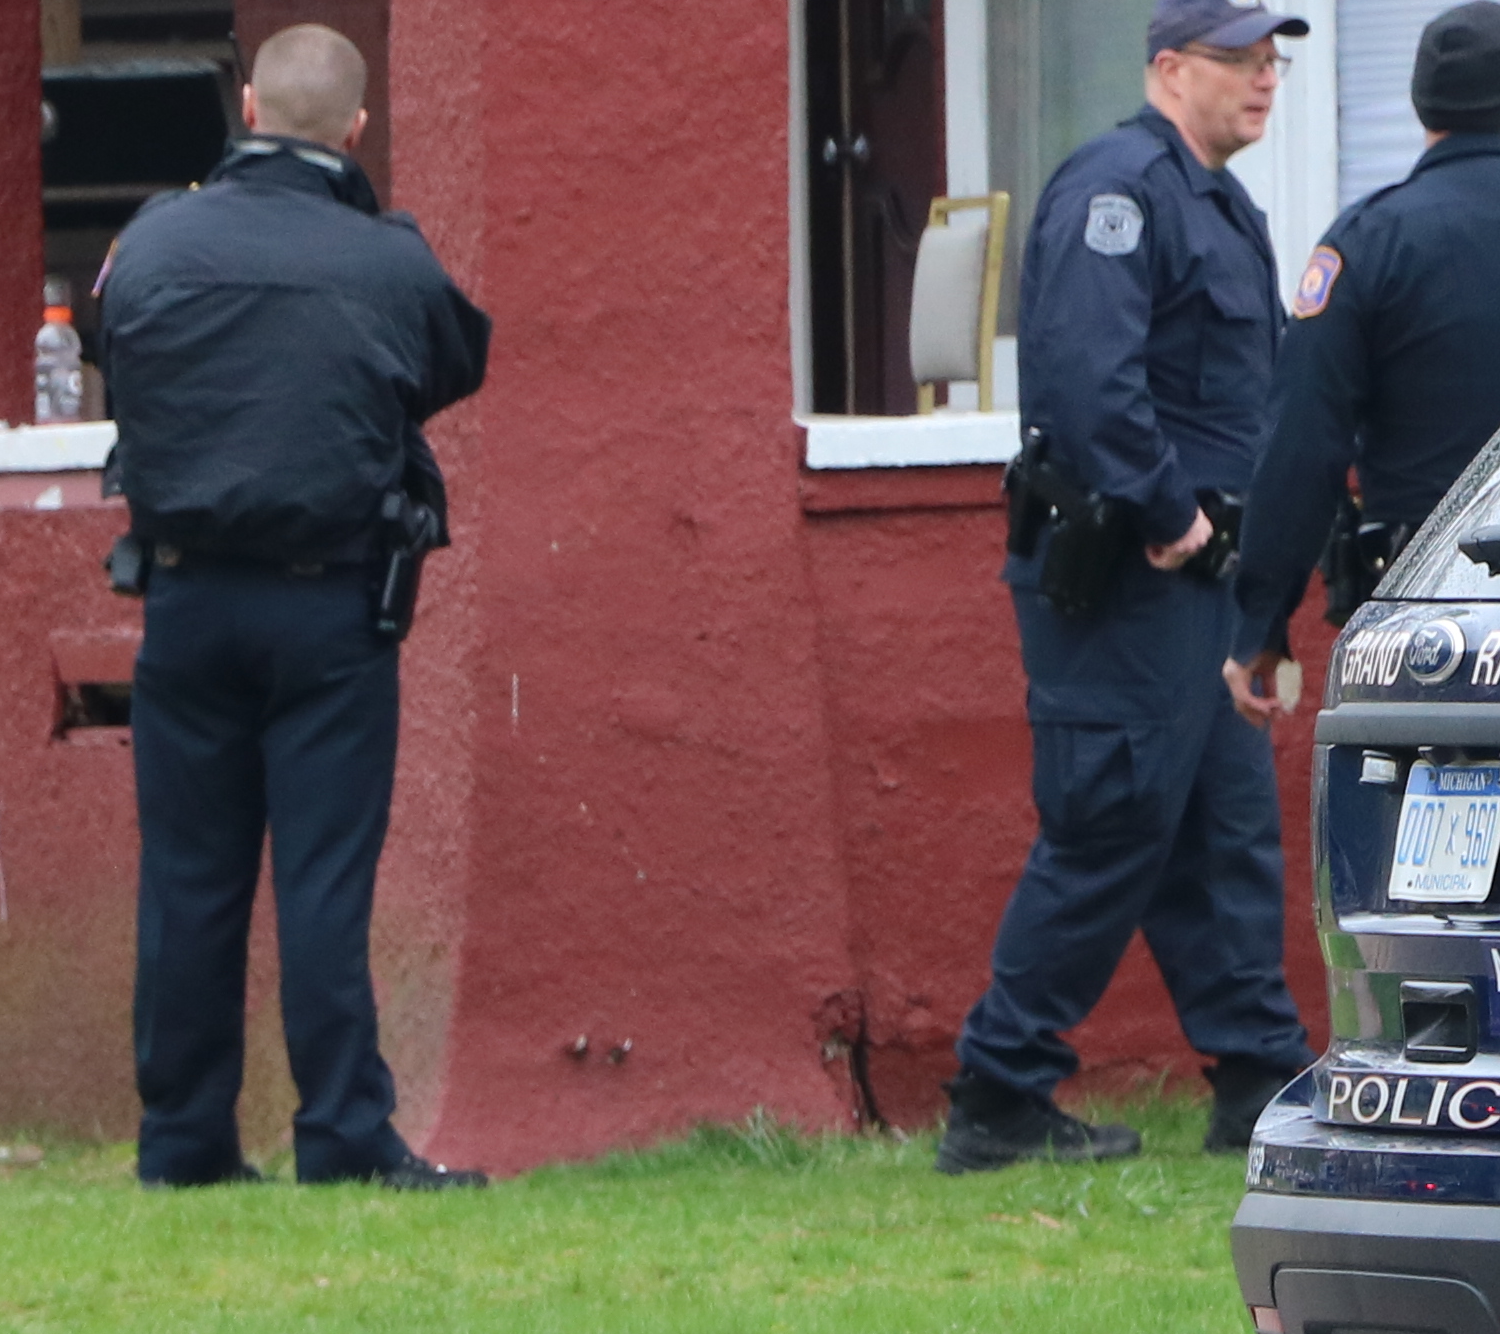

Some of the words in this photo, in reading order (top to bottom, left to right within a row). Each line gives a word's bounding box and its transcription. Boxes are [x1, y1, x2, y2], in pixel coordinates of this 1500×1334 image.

[1341, 630, 1411, 686] GRAND
[1409, 629, 1444, 667] Ford
[1438, 771, 1486, 791] MICHIGAN
[1397, 800, 1445, 867] 007
[1461, 801, 1498, 867] 960
